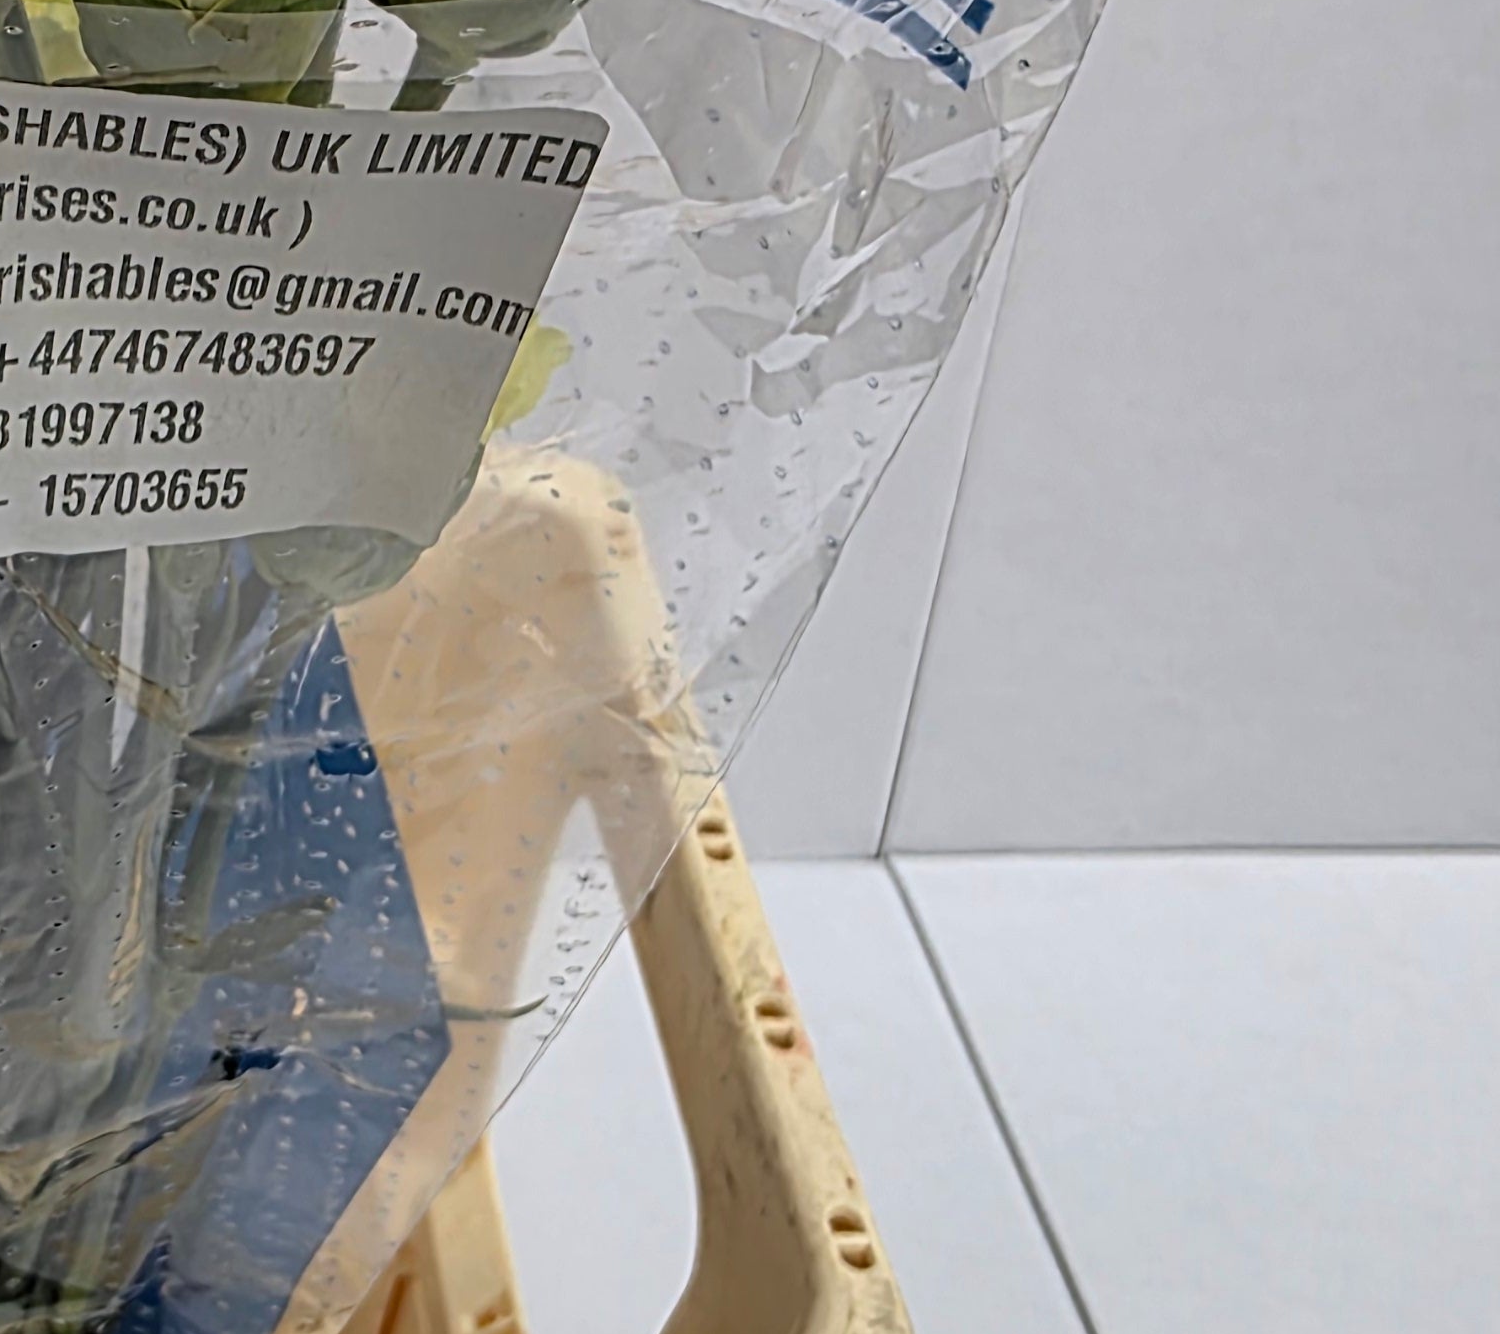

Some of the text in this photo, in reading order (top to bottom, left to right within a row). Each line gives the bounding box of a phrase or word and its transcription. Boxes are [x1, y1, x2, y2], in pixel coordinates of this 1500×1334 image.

[271, 130, 351, 175] UK
[366, 131, 601, 190] LIMITED
[38, 467, 248, 517] 15703655
